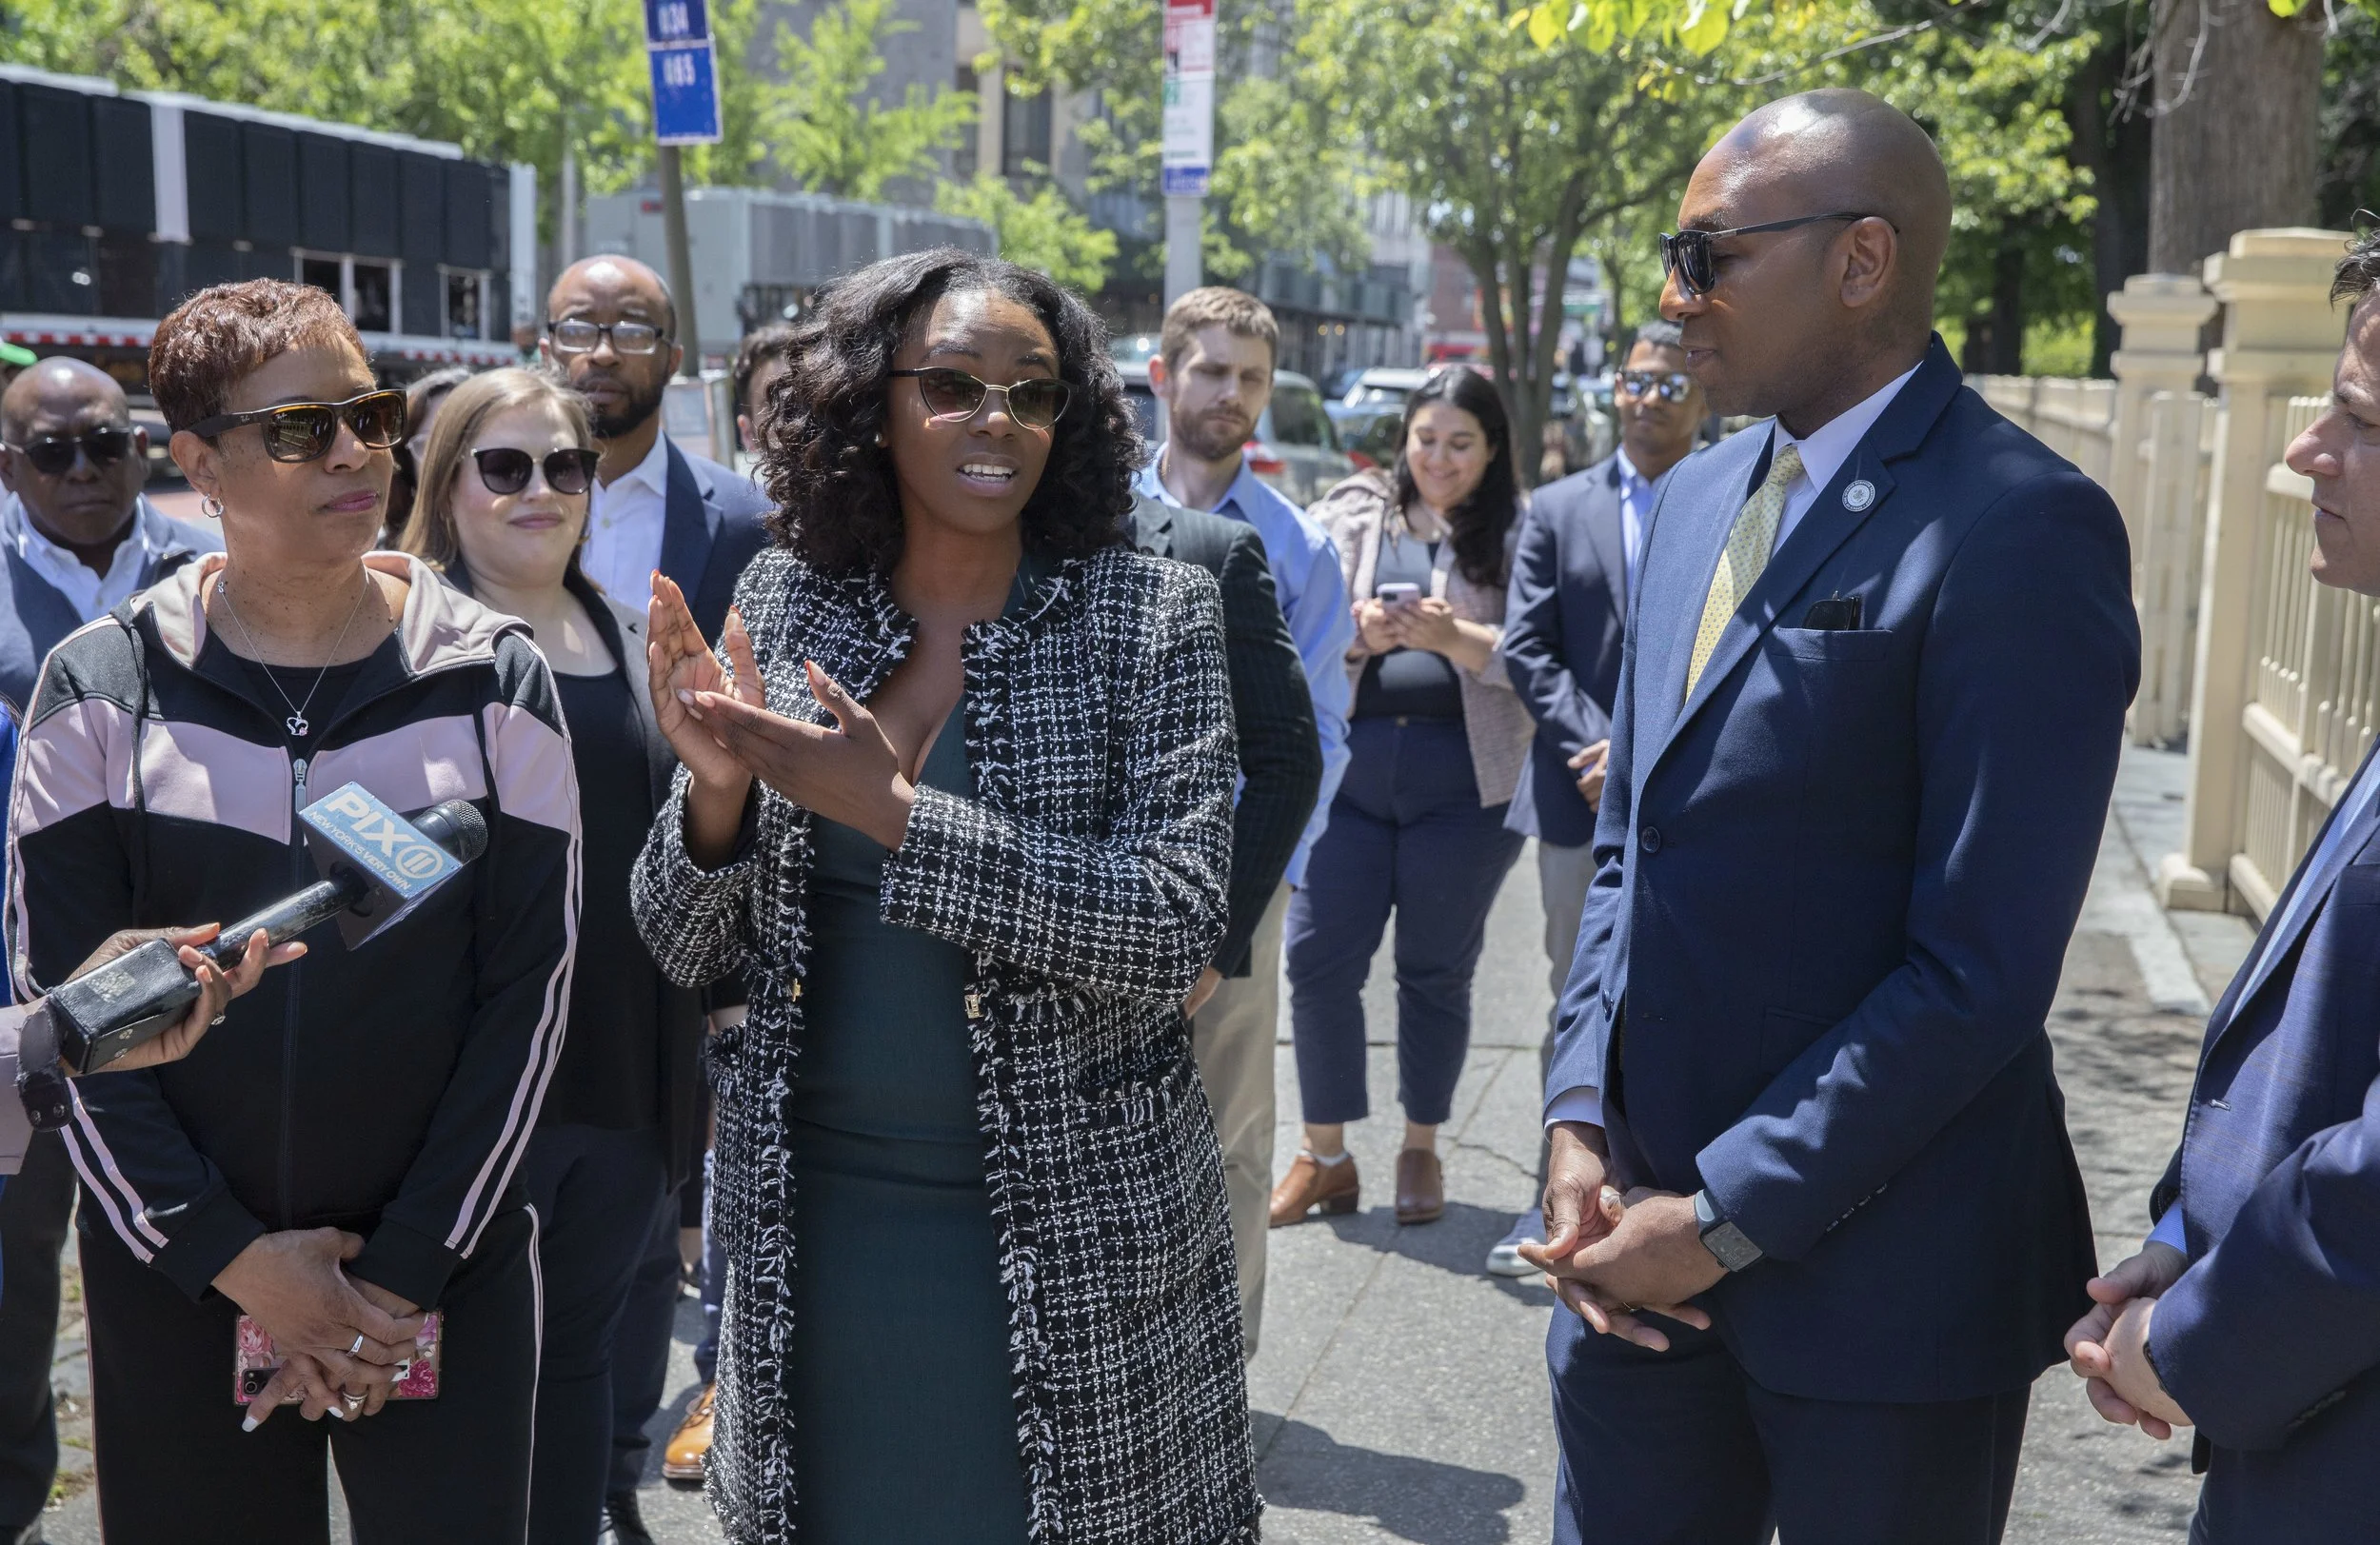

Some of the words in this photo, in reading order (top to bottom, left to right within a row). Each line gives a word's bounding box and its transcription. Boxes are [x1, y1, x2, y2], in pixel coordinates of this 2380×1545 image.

[308, 811, 333, 829] NEW
[330, 826, 366, 854] YORK'S
[364, 851, 390, 872] VERY
[386, 871, 411, 889] OWN
[324, 790, 416, 857] PIX
